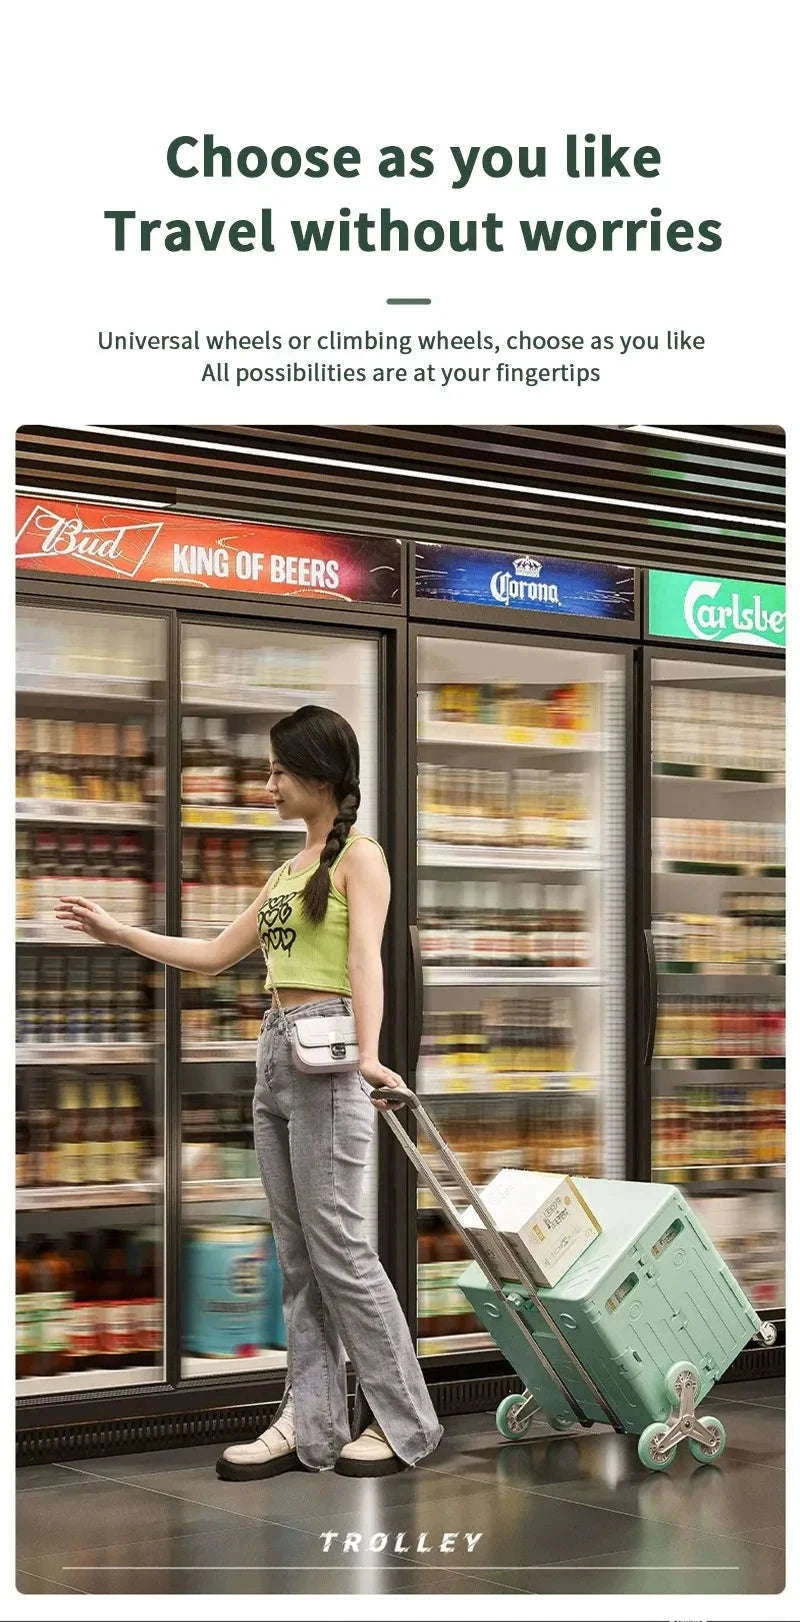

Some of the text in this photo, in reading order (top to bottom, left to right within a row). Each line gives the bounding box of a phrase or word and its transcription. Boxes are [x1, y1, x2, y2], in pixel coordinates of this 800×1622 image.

[36, 515, 124, 559] Bud
[173, 543, 339, 589] KING OF BEERS
[489, 571, 559, 605] Corona
